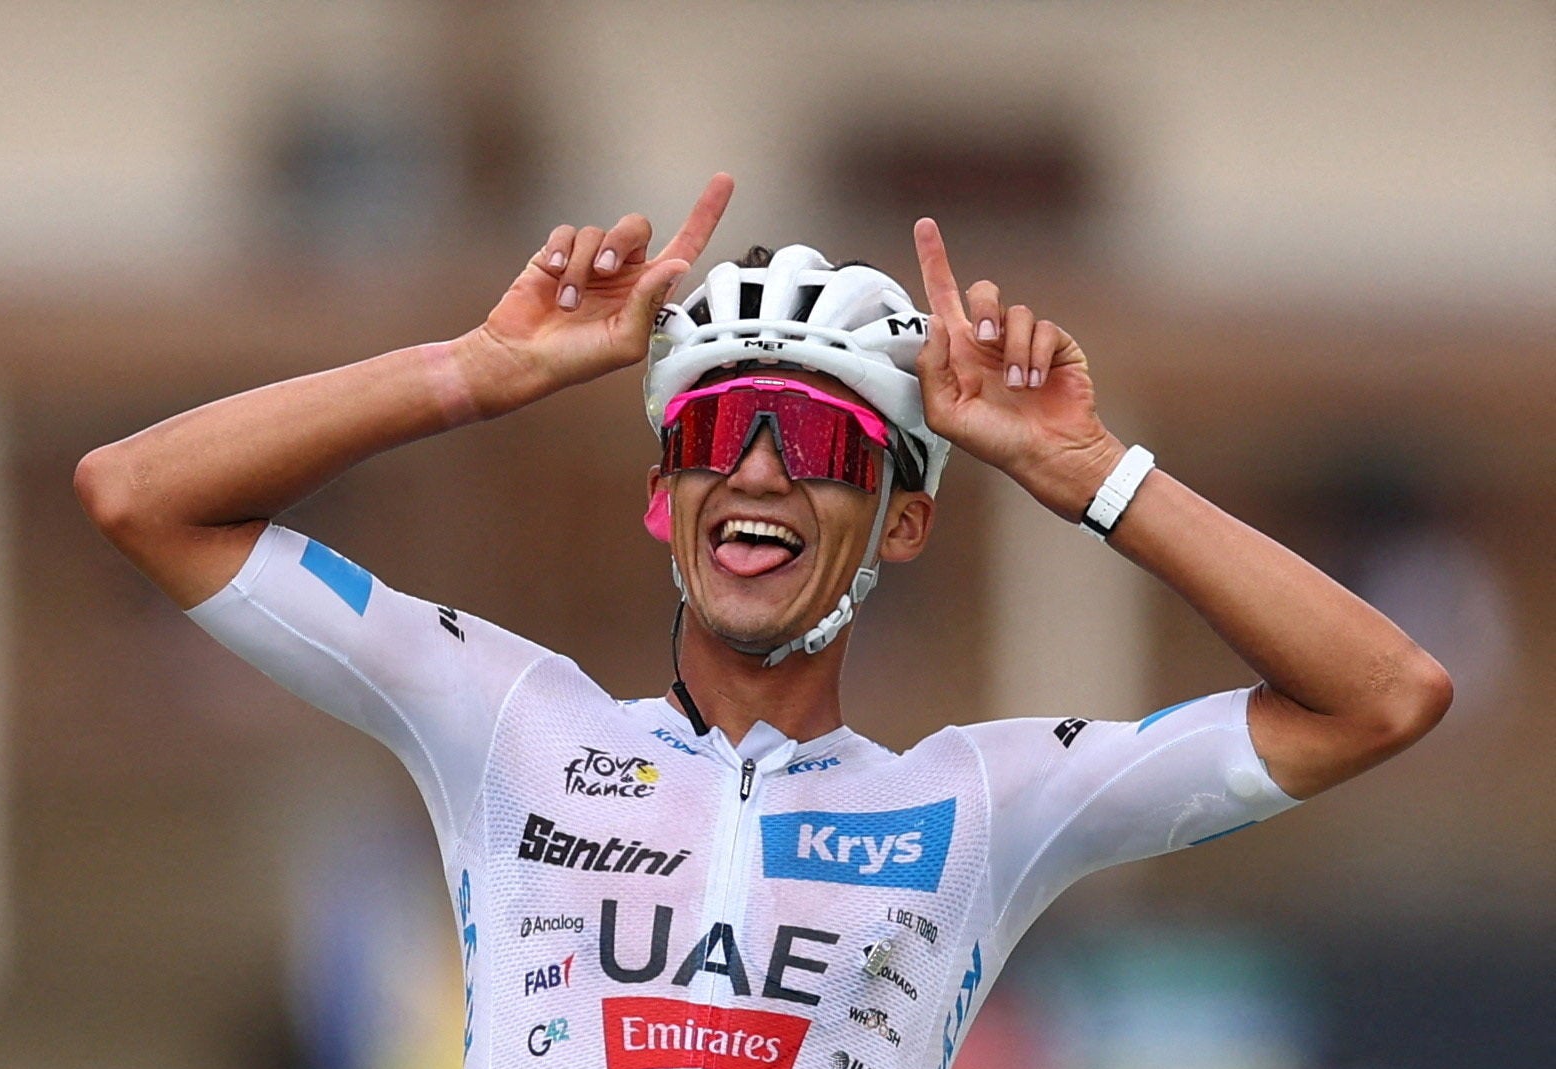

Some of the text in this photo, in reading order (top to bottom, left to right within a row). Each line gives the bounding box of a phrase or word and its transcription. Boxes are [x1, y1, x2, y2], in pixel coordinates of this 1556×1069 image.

[788, 757, 841, 775] Krys
[518, 813, 692, 877] Santini
[797, 824, 922, 874] Krys
[533, 914, 584, 933] Analog
[896, 910, 913, 929] DEL
[915, 916, 938, 944] TORO
[600, 900, 840, 1006] UAE
[877, 966, 917, 1001] OLNAGO
[528, 1018, 570, 1056] G42
[621, 1016, 781, 1064] Emirates
